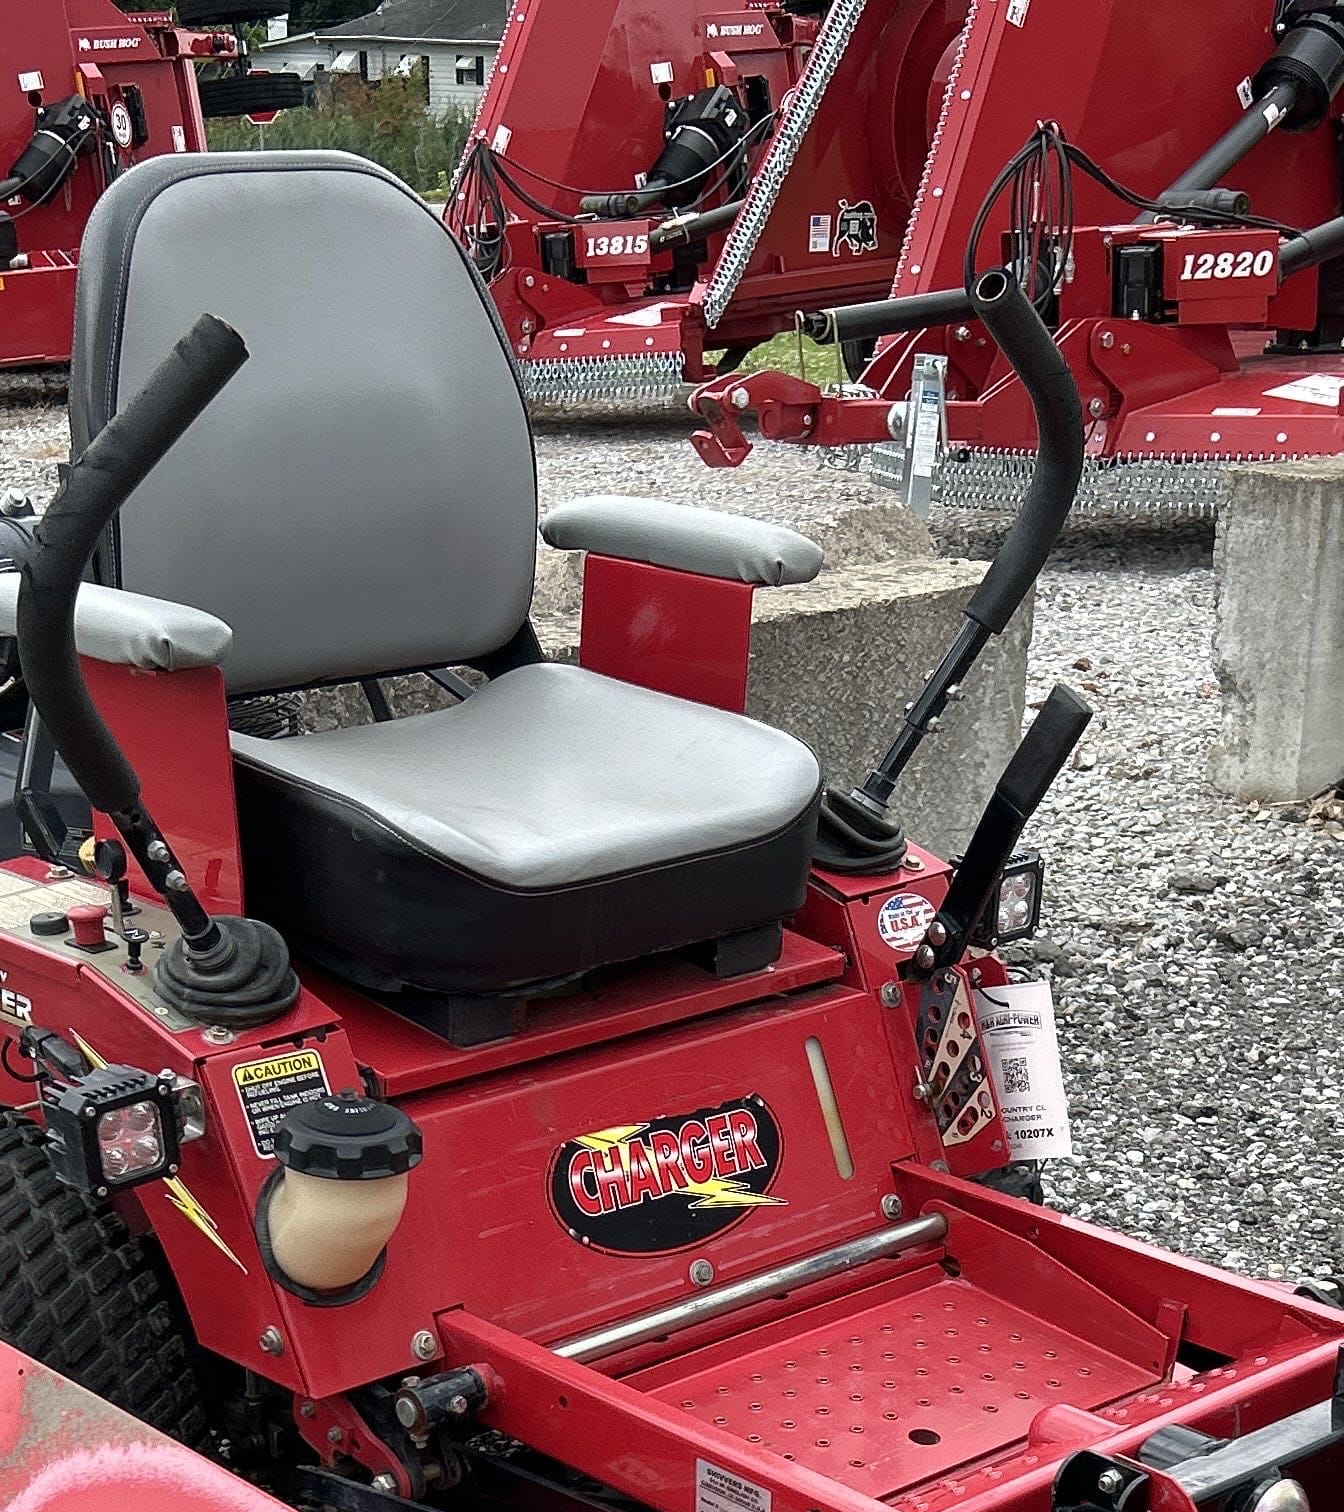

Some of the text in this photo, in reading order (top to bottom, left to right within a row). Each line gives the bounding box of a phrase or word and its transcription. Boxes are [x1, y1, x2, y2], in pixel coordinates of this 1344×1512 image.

[93, 38, 140, 49] BUSH HOG
[116, 114, 127, 130] 30
[586, 234, 649, 257] 13815
[1180, 250, 1274, 281] 12820
[254, 1056, 312, 1079] CAUTION
[970, 1071, 983, 1083] 3
[981, 1107, 993, 1120] 2
[1001, 1105, 1033, 1114] OUNTRY
[1014, 1127, 1054, 1140] 10207X
[568, 1108, 768, 1216] CHARGER
